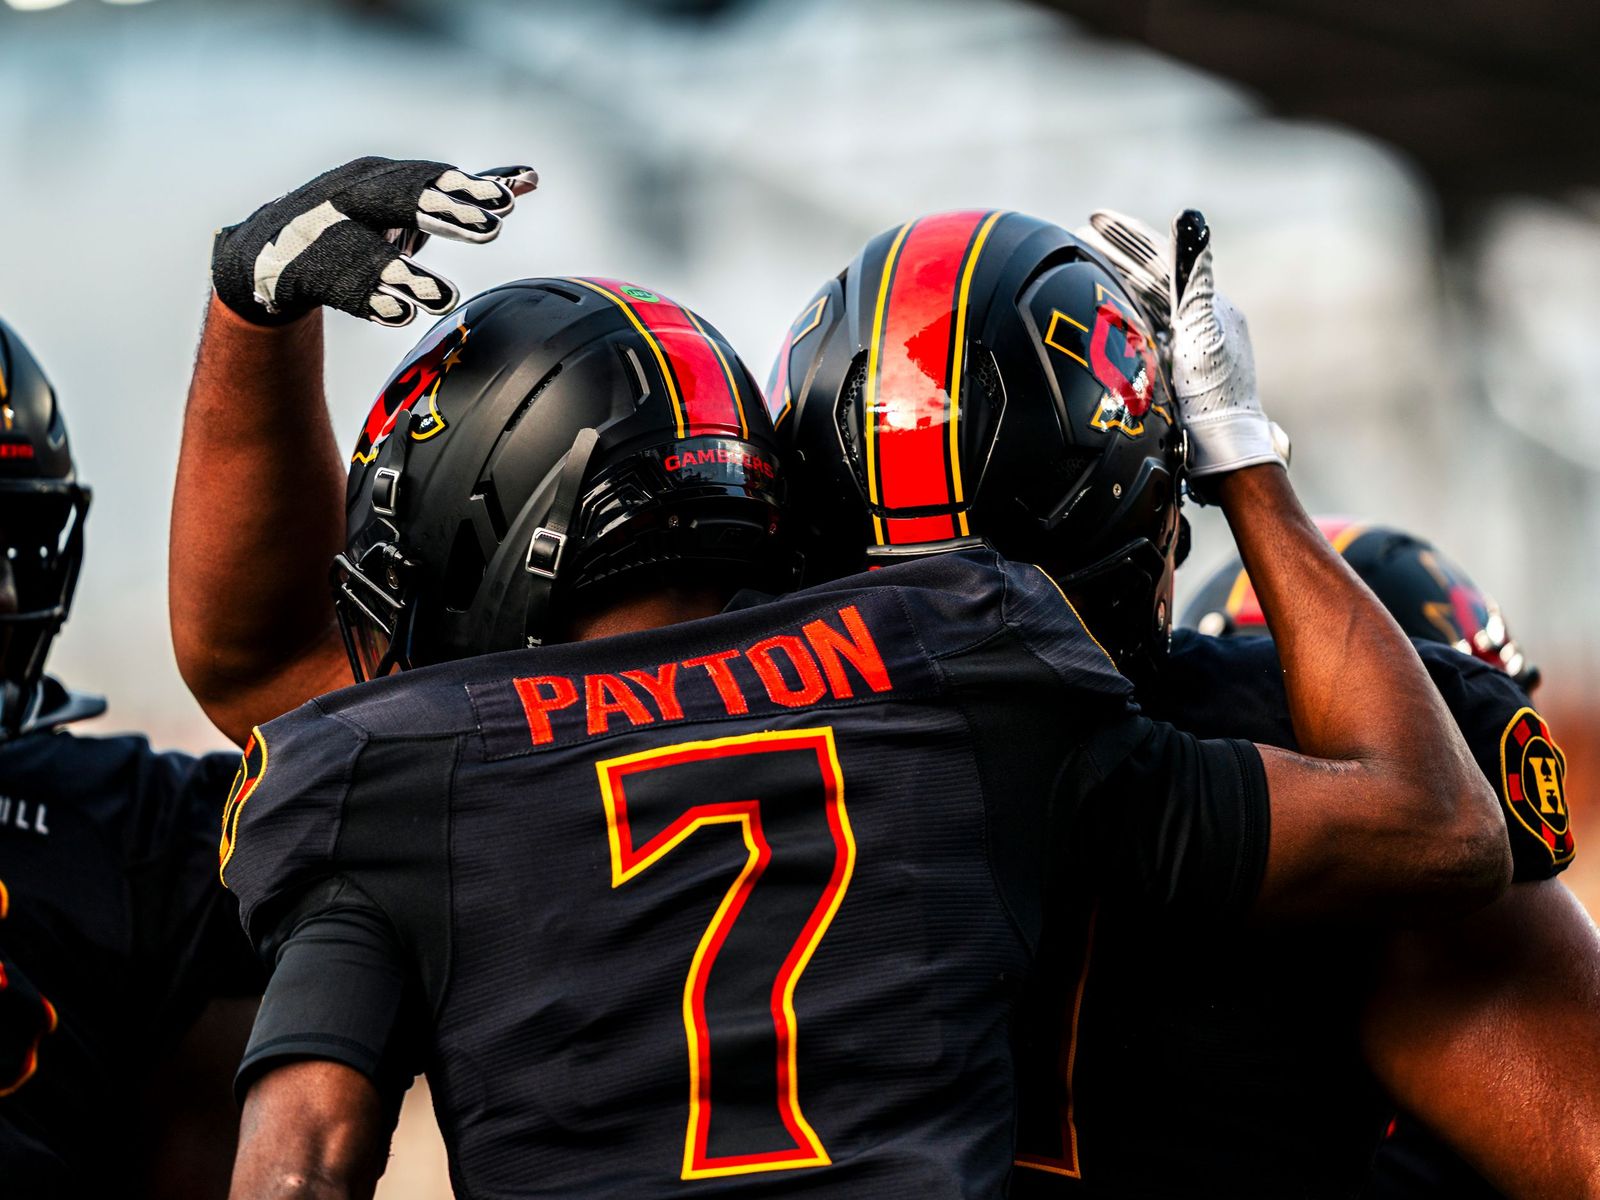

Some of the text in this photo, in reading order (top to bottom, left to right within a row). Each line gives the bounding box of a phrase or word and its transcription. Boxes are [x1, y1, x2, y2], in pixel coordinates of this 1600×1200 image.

[513, 605, 893, 745] PAYTON
[1529, 757, 1565, 815] H
[595, 726, 856, 1180] 7
